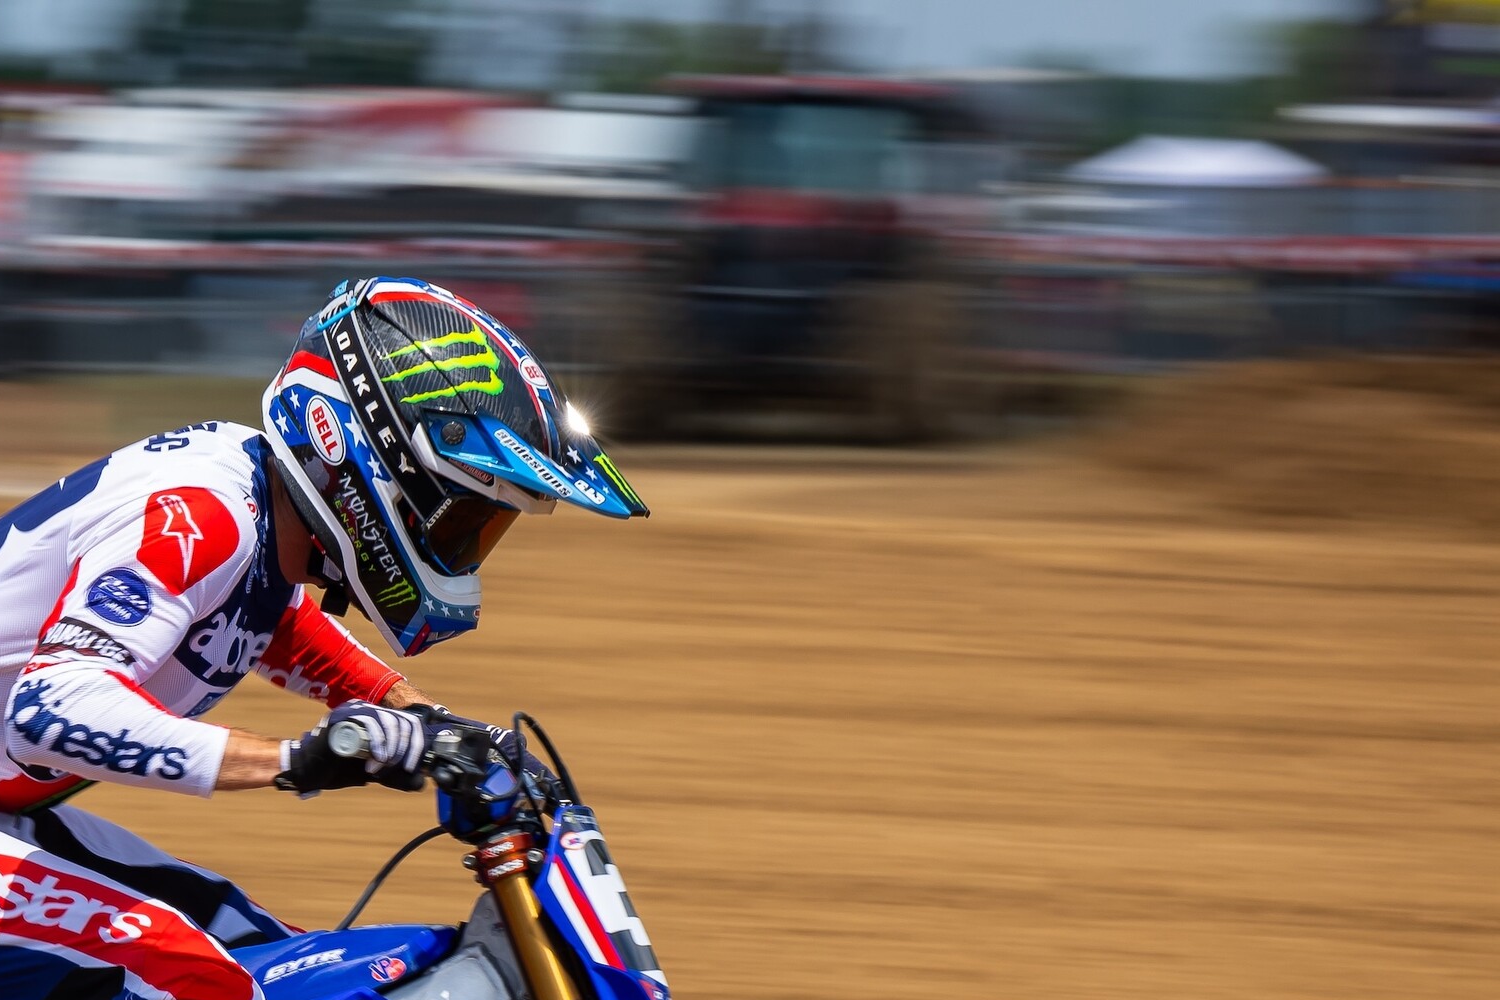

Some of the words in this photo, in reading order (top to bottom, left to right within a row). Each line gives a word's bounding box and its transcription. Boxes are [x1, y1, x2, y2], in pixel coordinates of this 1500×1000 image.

[336, 330, 416, 474] OAKLEY
[524, 364, 546, 380] BEL
[311, 405, 338, 457] BELL
[334, 499, 377, 572] ENERGY
[338, 475, 402, 584] MONSTER
[426, 497, 453, 530] OAKLEY
